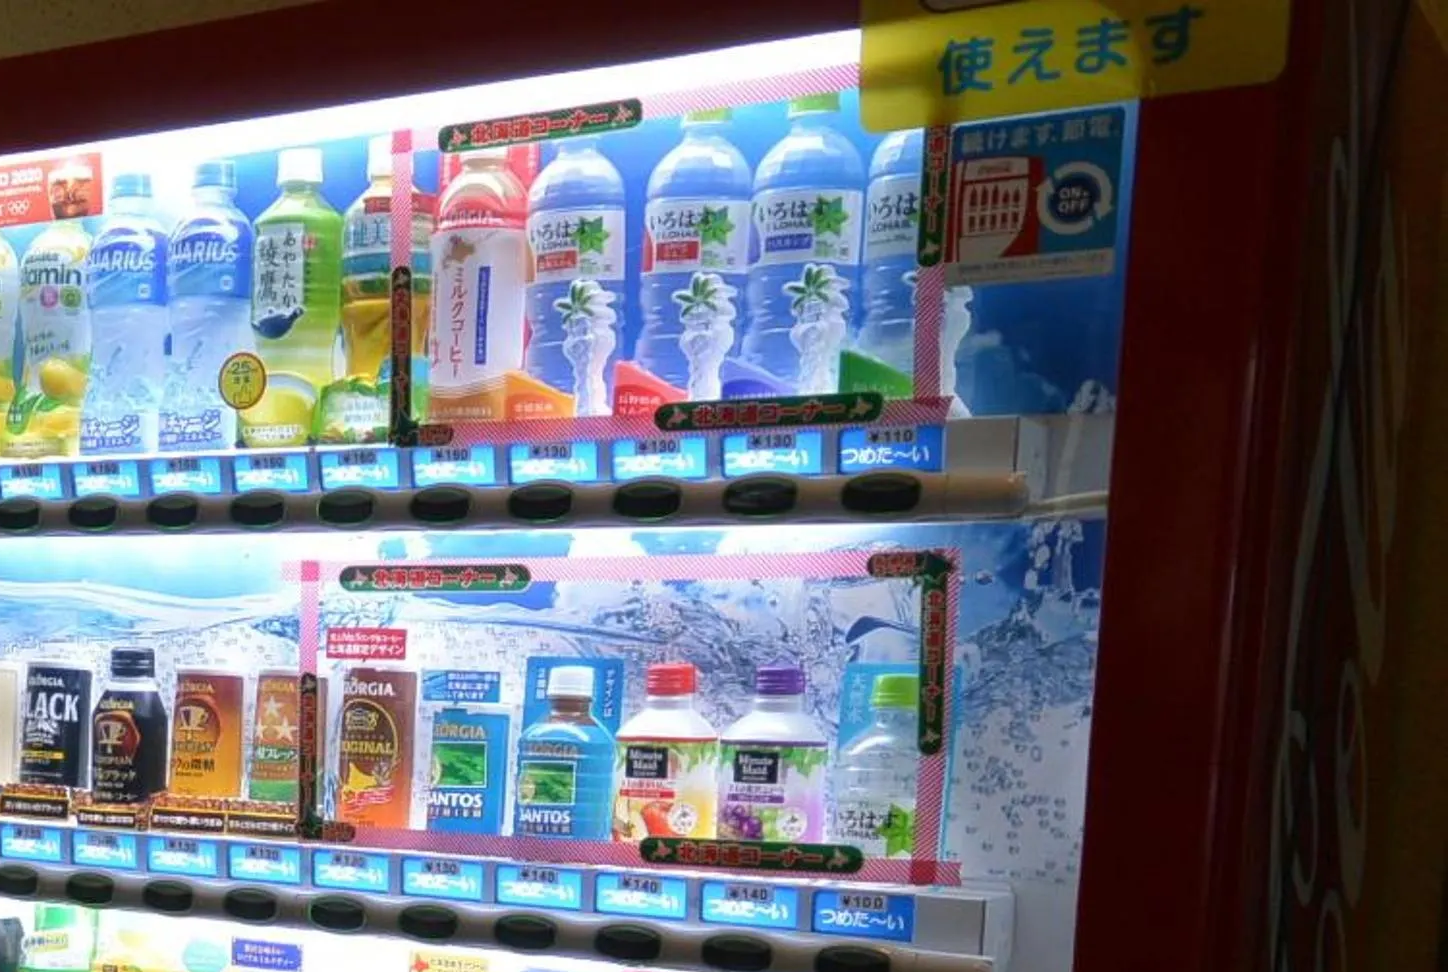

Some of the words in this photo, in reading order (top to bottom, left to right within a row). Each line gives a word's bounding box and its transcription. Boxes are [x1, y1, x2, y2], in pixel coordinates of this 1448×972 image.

[936, 7, 1204, 96] 使えます
[281, 231, 298, 307] あやたか
[23, 692, 81, 723] LACK
[678, 842, 823, 867] 北海道コーナー
[819, 908, 905, 930] つめた〜い
